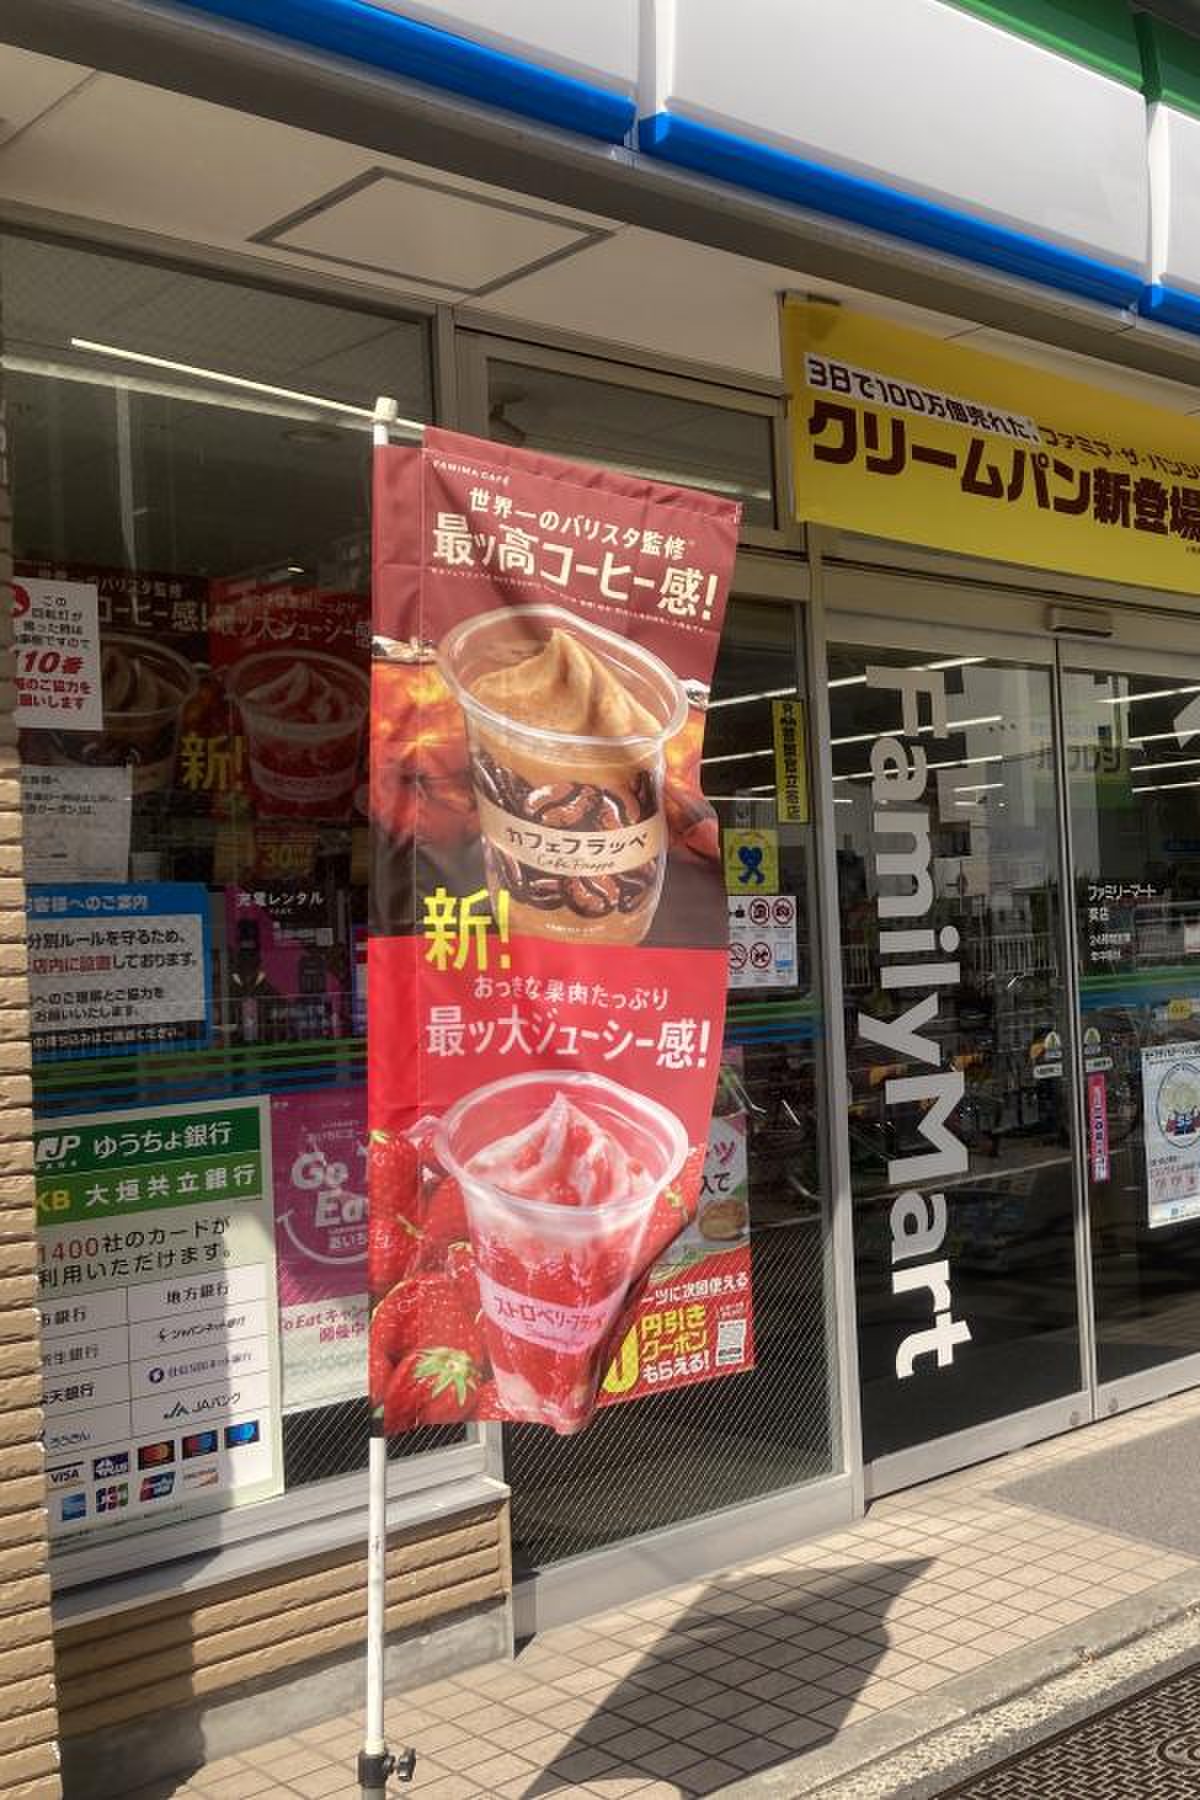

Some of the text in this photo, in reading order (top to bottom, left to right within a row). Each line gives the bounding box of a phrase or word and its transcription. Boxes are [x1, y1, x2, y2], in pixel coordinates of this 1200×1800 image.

[808, 358, 1039, 441] 3日で100万個売れた、
[469, 486, 687, 561] 世界一のバリスタ監修
[182, 737, 247, 791] 新!
[506, 829, 650, 856] カフェフラッペ
[422, 887, 512, 972] 新!
[473, 974, 669, 1012] おっきな果肉たっぷり
[426, 1003, 712, 1069] 最ッ大ジューシー感!
[857, 665, 972, 1380] FamilyMart
[93, 1121, 233, 1160] ゆうちょ銀行
[85, 1163, 257, 1207] 大垣共立銀行
[316, 1190, 368, 1228] Ea
[38, 1242, 231, 1289] 利用いただけます。
[167, 1282, 230, 1305] 地方銀行
[641, 1271, 750, 1304] ーツに次回使える
[642, 1352, 712, 1385] もらえる!
[51, 1467, 81, 1483] VISA
